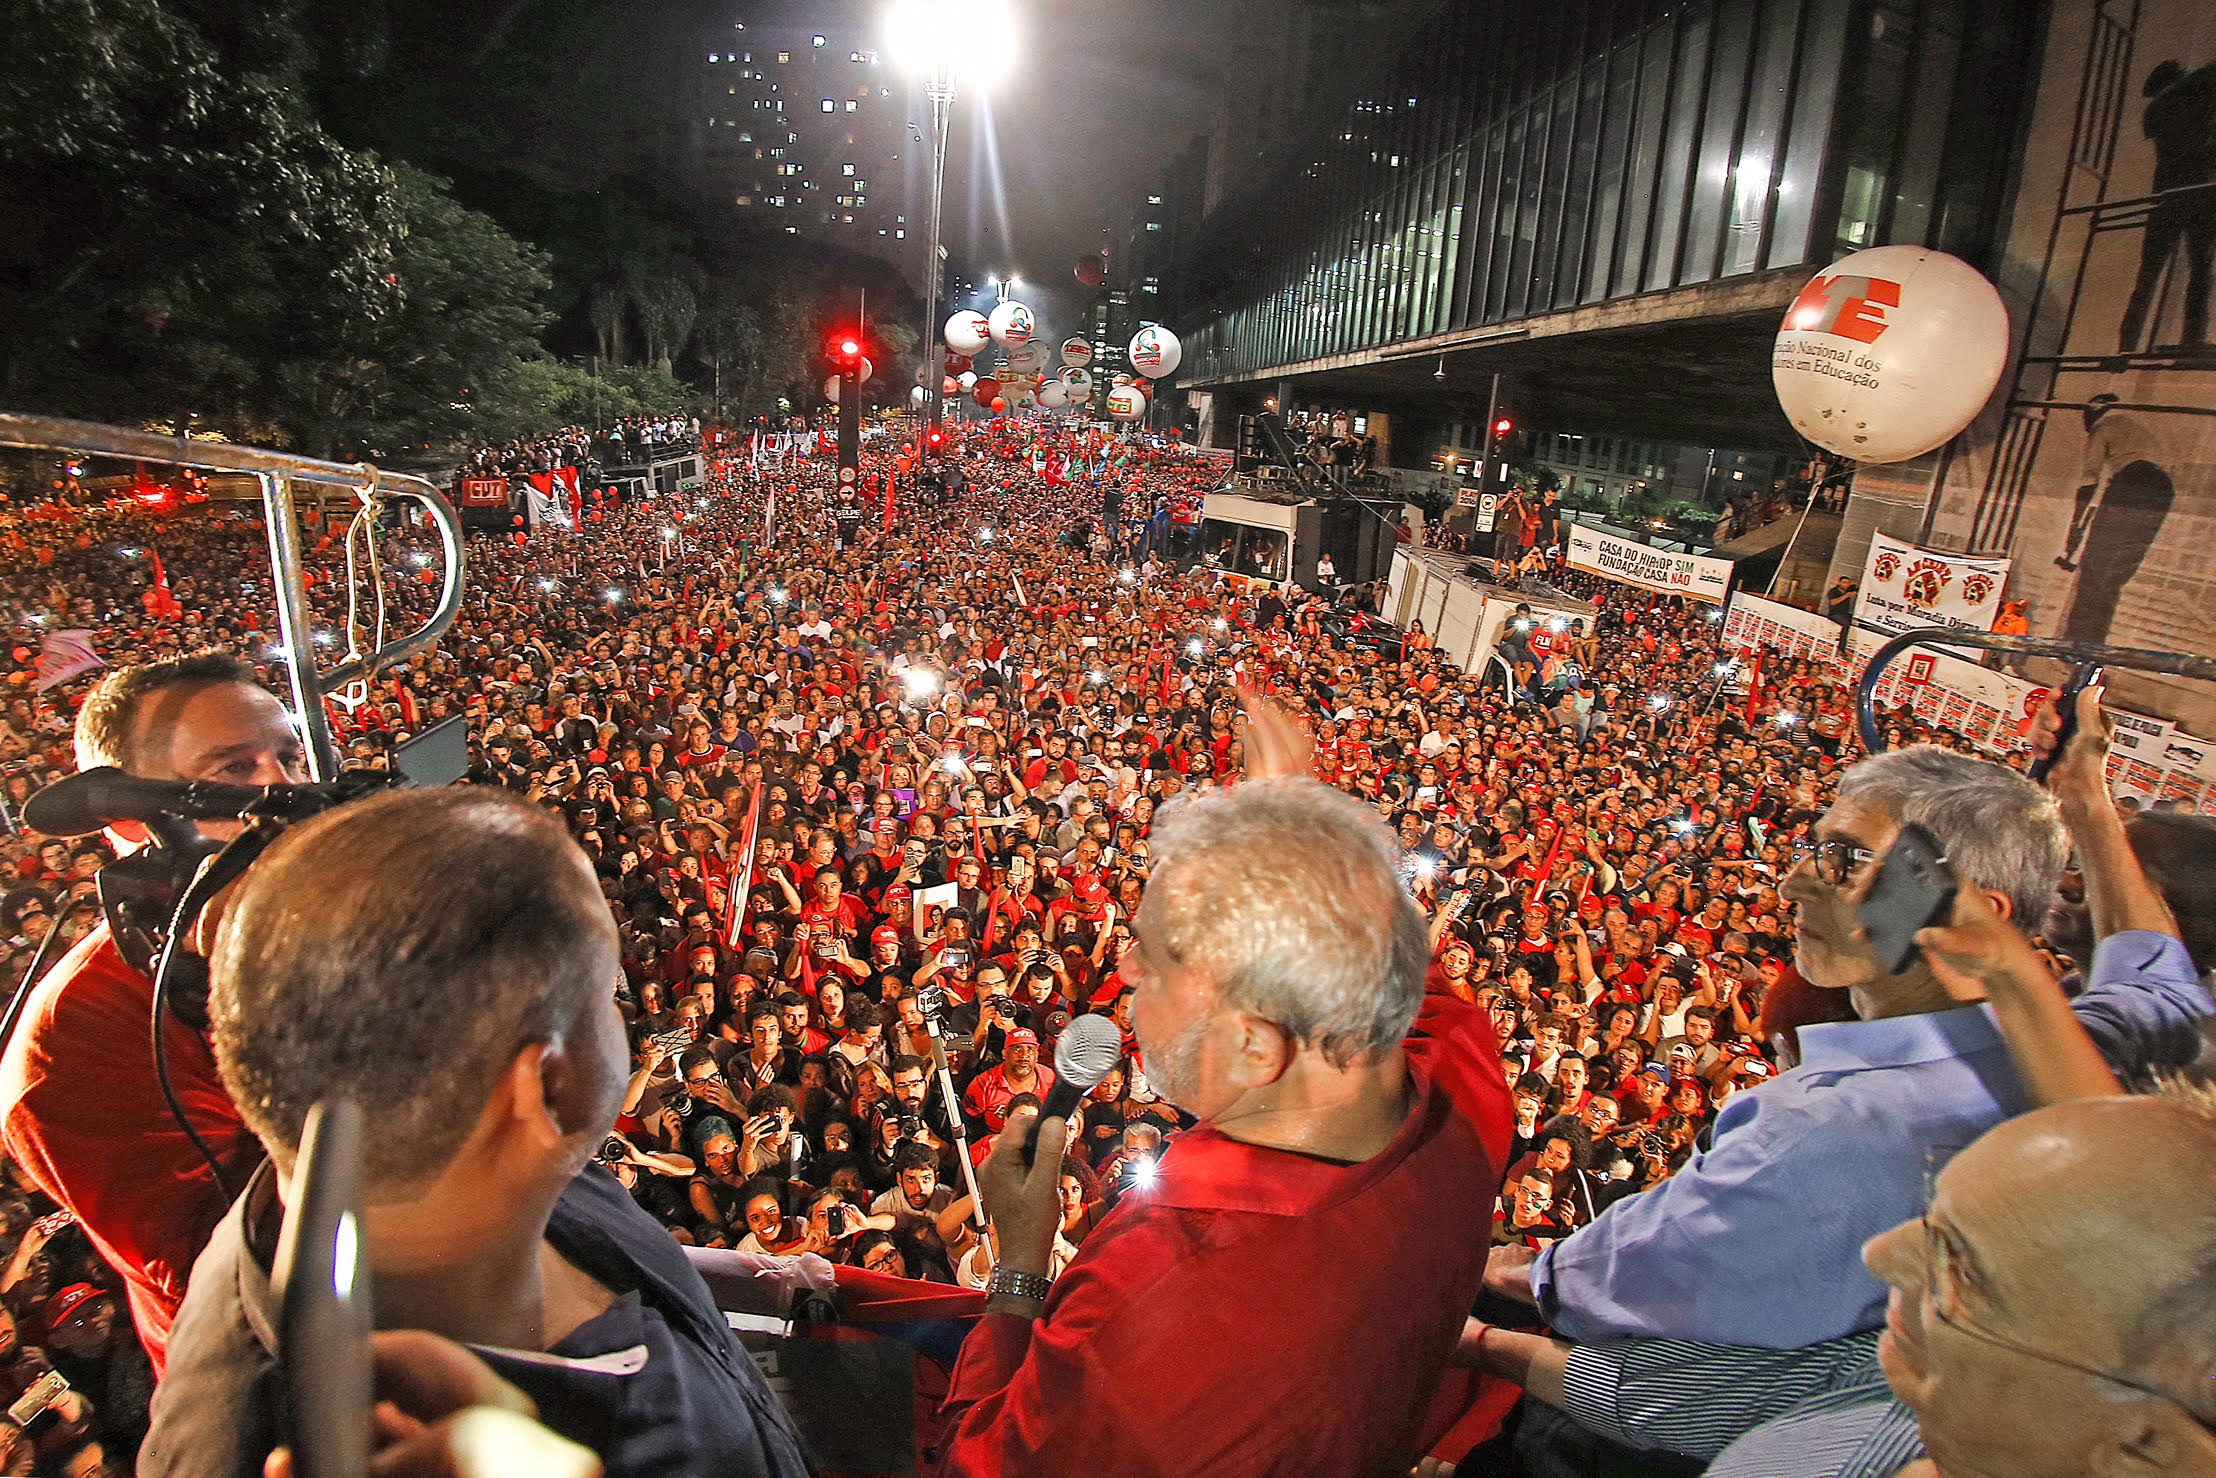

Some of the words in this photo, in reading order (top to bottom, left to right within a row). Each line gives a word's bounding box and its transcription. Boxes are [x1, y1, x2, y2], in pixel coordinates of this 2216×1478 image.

[1796, 341, 1853, 364] Nacional
[1854, 353, 1882, 373] dos
[1813, 358, 1880, 390] Educação
[1598, 554, 1645, 577] FUNDAÇÃO
[1644, 568, 1668, 583] CASA
[1670, 572, 1691, 586] NÃO
[1599, 540, 1623, 557] CASA
[1624, 548, 1638, 562] DO
[1675, 559, 1694, 574] SIM
[1866, 592, 1886, 607] Luta
[1887, 601, 1904, 615] por
[1907, 604, 1946, 624] Moradia
